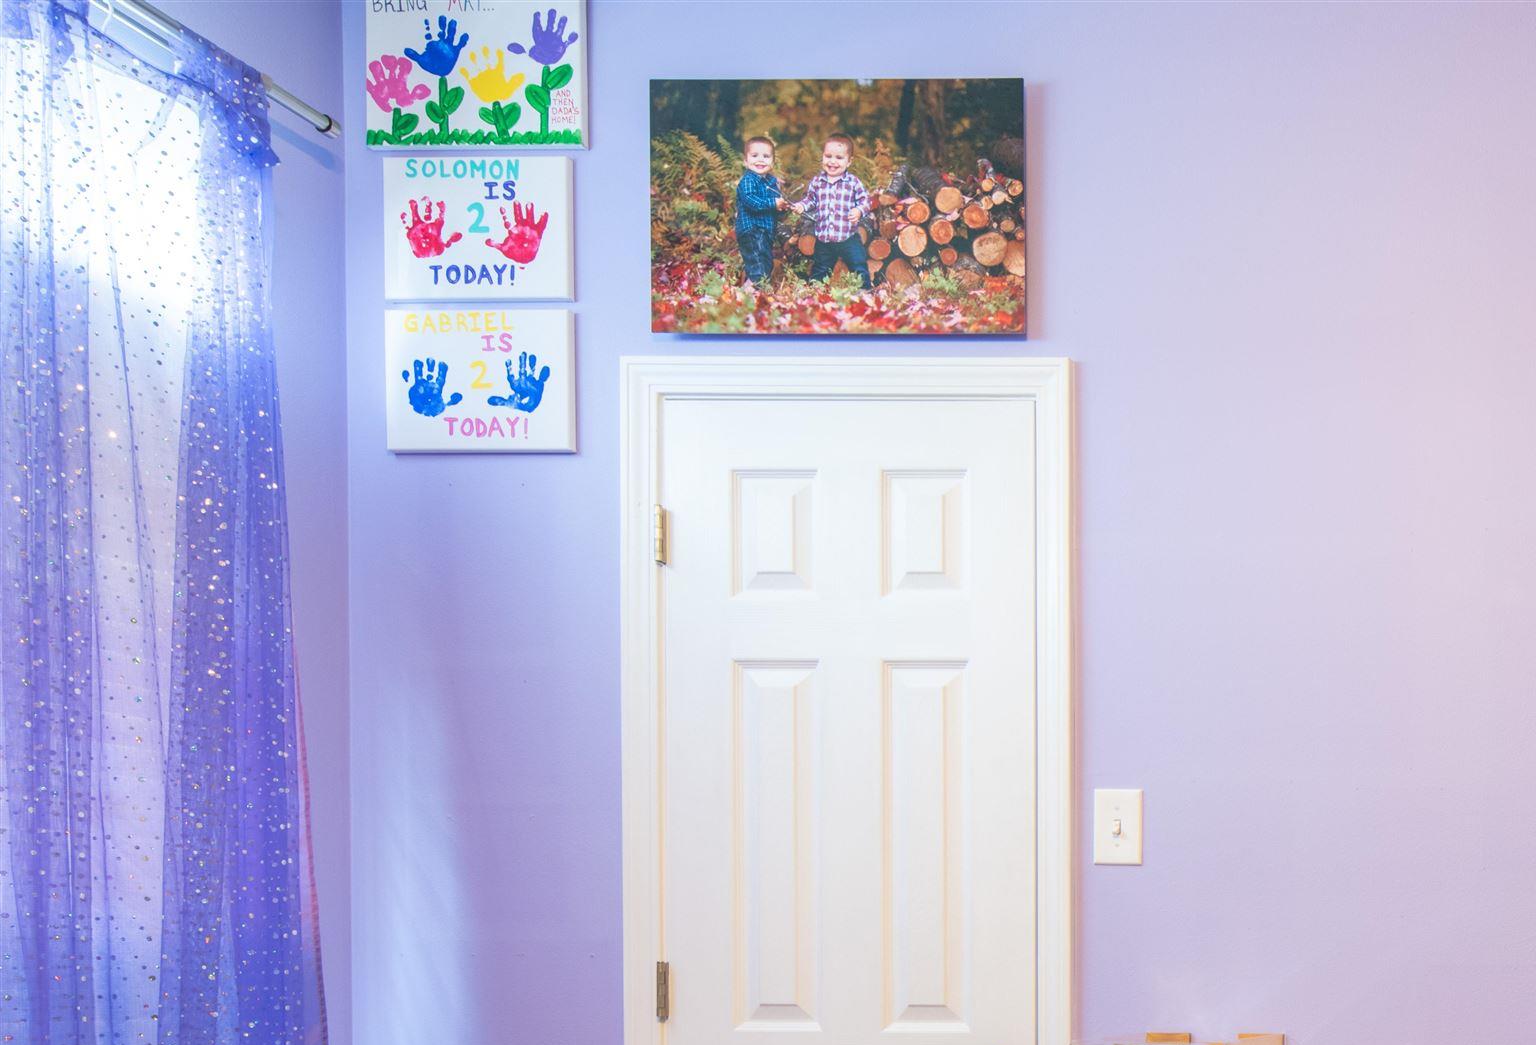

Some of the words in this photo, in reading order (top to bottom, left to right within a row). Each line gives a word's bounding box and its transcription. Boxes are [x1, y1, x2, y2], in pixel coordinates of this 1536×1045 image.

[372, 0, 428, 13] BRING
[552, 98, 575, 108] THEN
[405, 158, 519, 181] SOLOMON
[484, 180, 516, 201] IS
[466, 202, 489, 233] 2
[429, 264, 515, 286] TODAY!
[402, 312, 515, 334] GABRIEL
[481, 333, 512, 353] IS
[469, 360, 493, 390] 2
[444, 417, 529, 440] TODAY!
